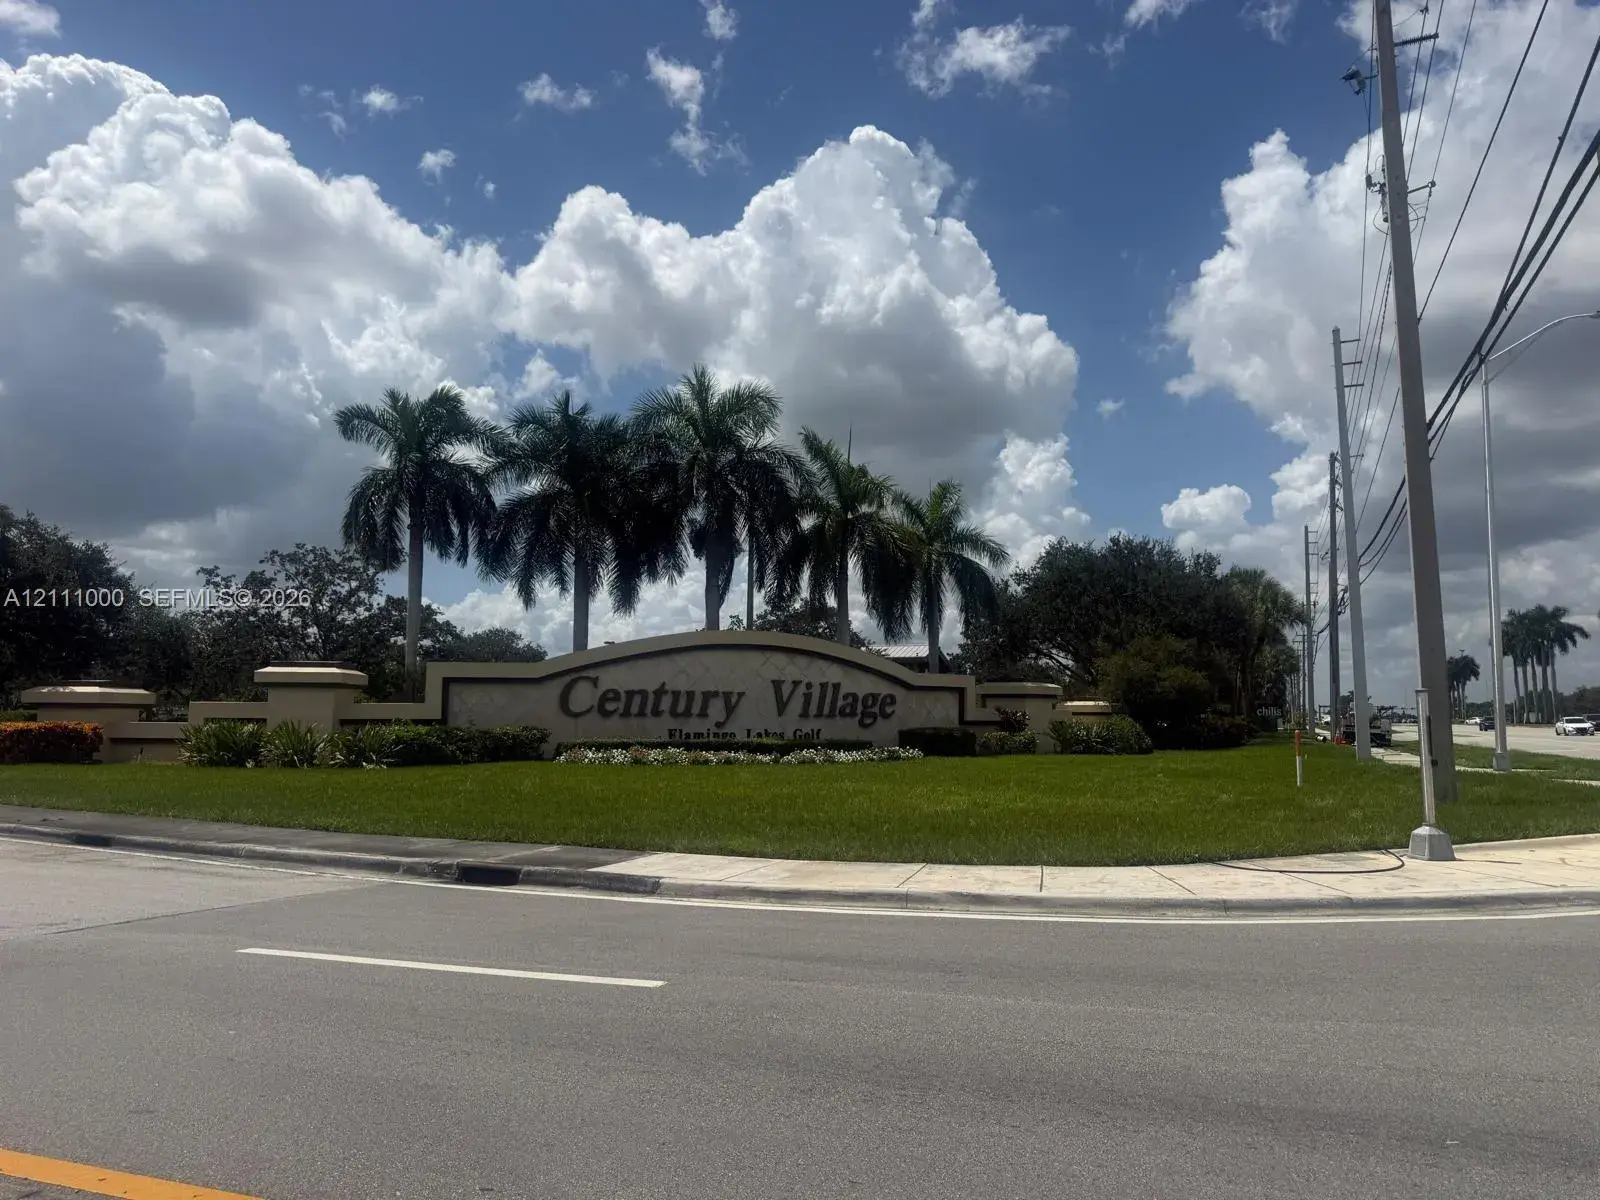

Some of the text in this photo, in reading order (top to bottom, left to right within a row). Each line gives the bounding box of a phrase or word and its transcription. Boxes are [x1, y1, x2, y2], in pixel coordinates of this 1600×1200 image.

[559, 675, 897, 729] Century Village
[667, 728, 822, 741] Flamingo Lakes Golf
